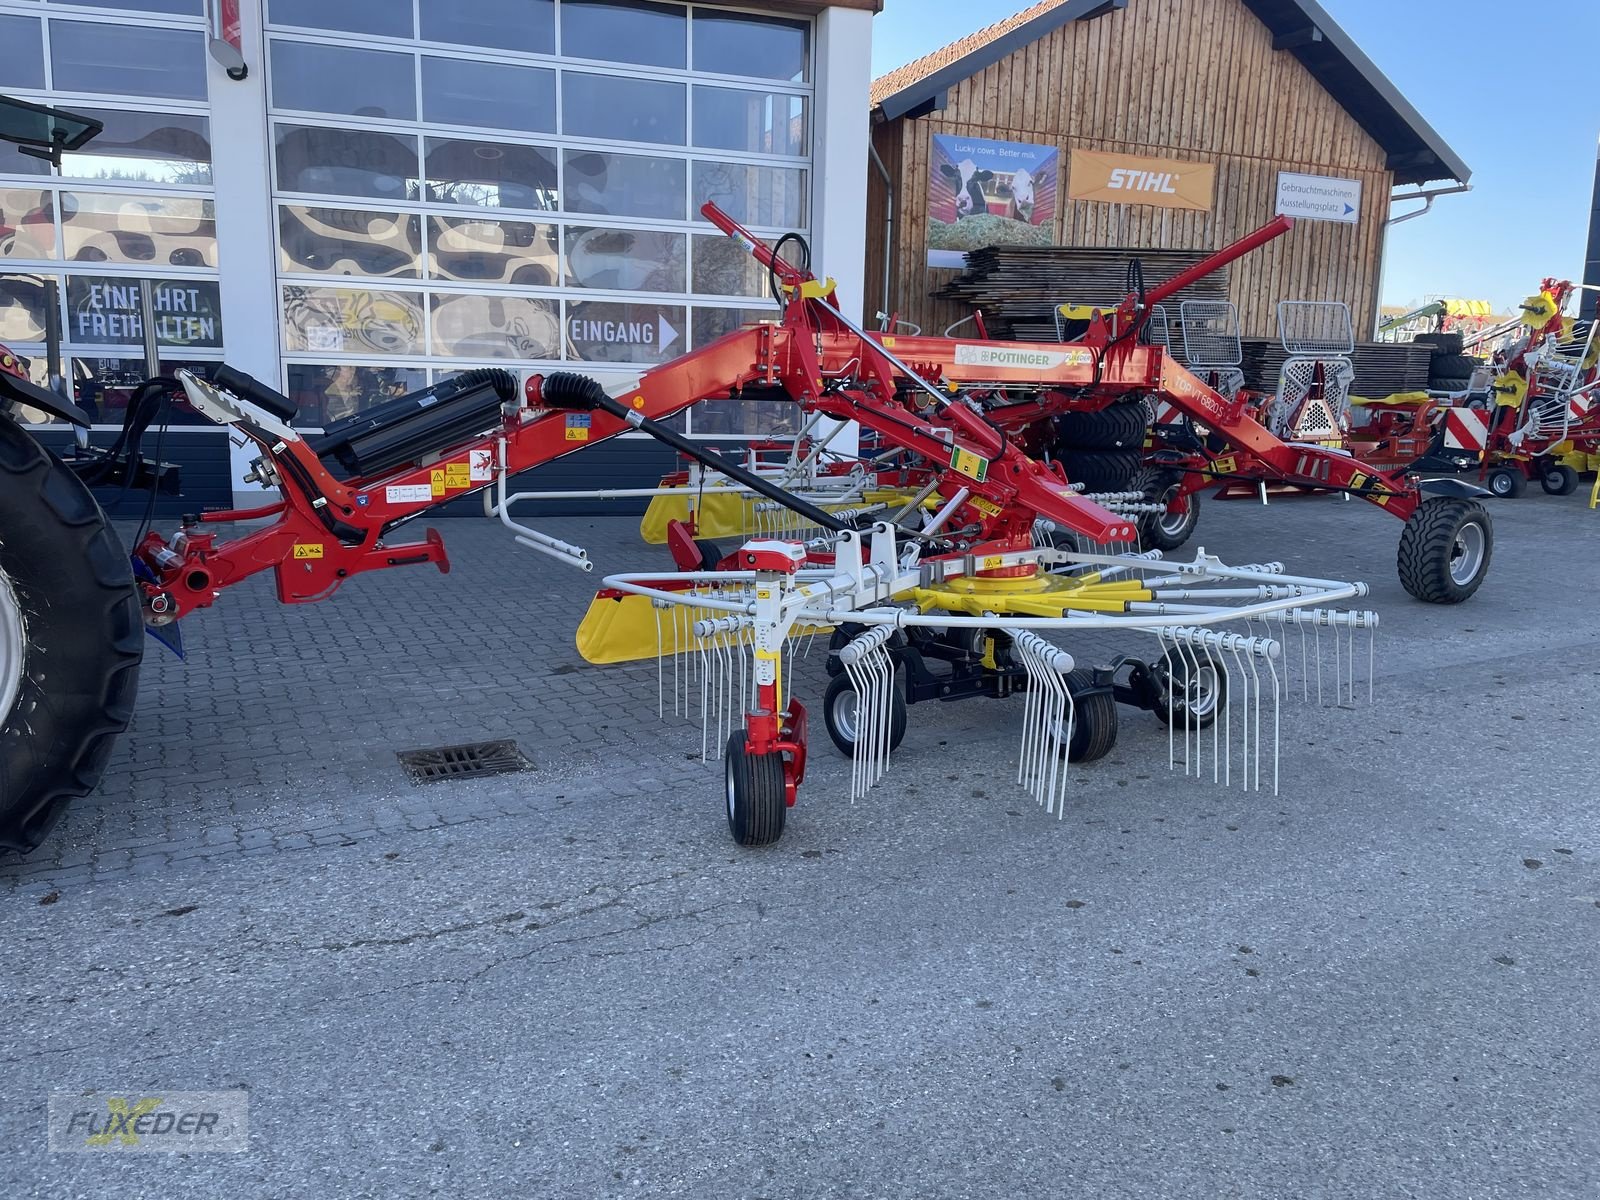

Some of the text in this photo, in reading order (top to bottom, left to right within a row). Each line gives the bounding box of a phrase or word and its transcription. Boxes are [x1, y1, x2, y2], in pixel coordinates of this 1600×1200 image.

[954, 143, 976, 154] Lucky
[999, 148, 1020, 157] Better
[1280, 198, 1339, 212] Ausstellungsplatz
[571, 319, 654, 344] EINGANG
[1175, 375, 1224, 417] TOP VT 6820 S
